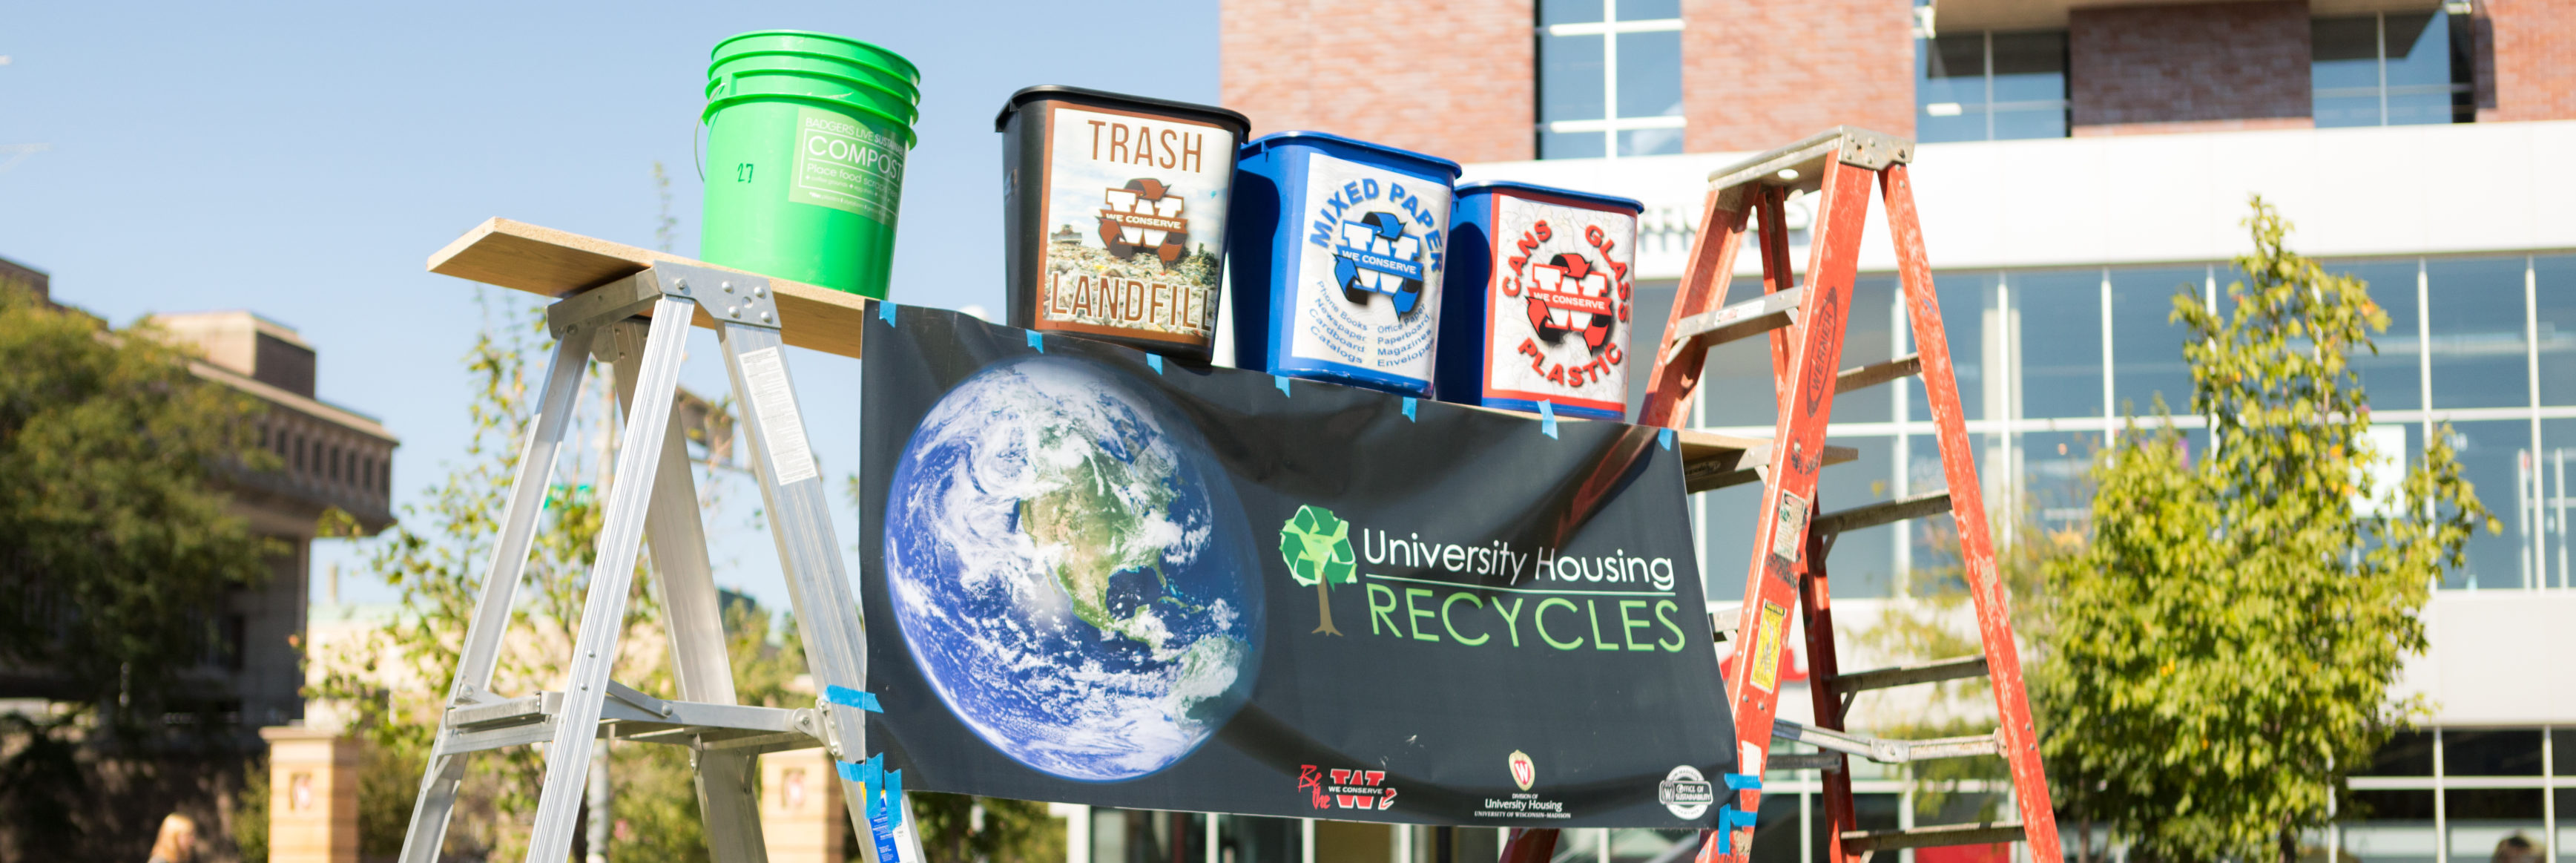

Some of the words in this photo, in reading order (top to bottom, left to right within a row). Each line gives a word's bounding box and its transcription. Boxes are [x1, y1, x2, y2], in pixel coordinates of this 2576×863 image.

[806, 117, 854, 136] BADGERS
[856, 128, 874, 142] LIVE
[1087, 119, 1202, 173] TRASH
[737, 163, 754, 183] 27
[807, 163, 837, 177] Place
[840, 169, 862, 183] food
[808, 136, 903, 181] COMPOST
[1106, 213, 1124, 222] WE
[1126, 216, 1181, 229] CONSERVE
[1309, 178, 1379, 249] MIXED
[1389, 182, 1443, 272] PAPER
[1342, 250, 1360, 261] WE
[1362, 255, 1417, 274] CONSERVE
[1502, 220, 1552, 297] CANS
[1584, 225, 1630, 322] GLASS
[1050, 272, 1212, 332] LANDFILL
[1317, 280, 1339, 312] Phone
[1340, 311, 1368, 331] Books
[1377, 324, 1403, 333] Office
[1404, 303, 1426, 327] Paper
[1533, 292, 1550, 302] WE
[1552, 295, 1605, 309] CONSERVE
[1309, 308, 1365, 352] Cardboard
[1314, 298, 1366, 341] Newspaper
[1377, 313, 1430, 345] Paperboard
[1311, 326, 1363, 363] Catalogs
[1377, 329, 1432, 355] Magazines
[1377, 338, 1434, 367] Envelopes
[1811, 310, 1833, 391] WERNER
[1518, 337, 1623, 387] PLASTIC
[1364, 528, 1528, 585] University
[1535, 546, 1675, 590] Housing
[1366, 583, 1686, 653] RECYCLES
[1485, 798, 1526, 811] University
[1529, 800, 1563, 812] Housing
[1676, 784, 1696, 793] OFFICE
